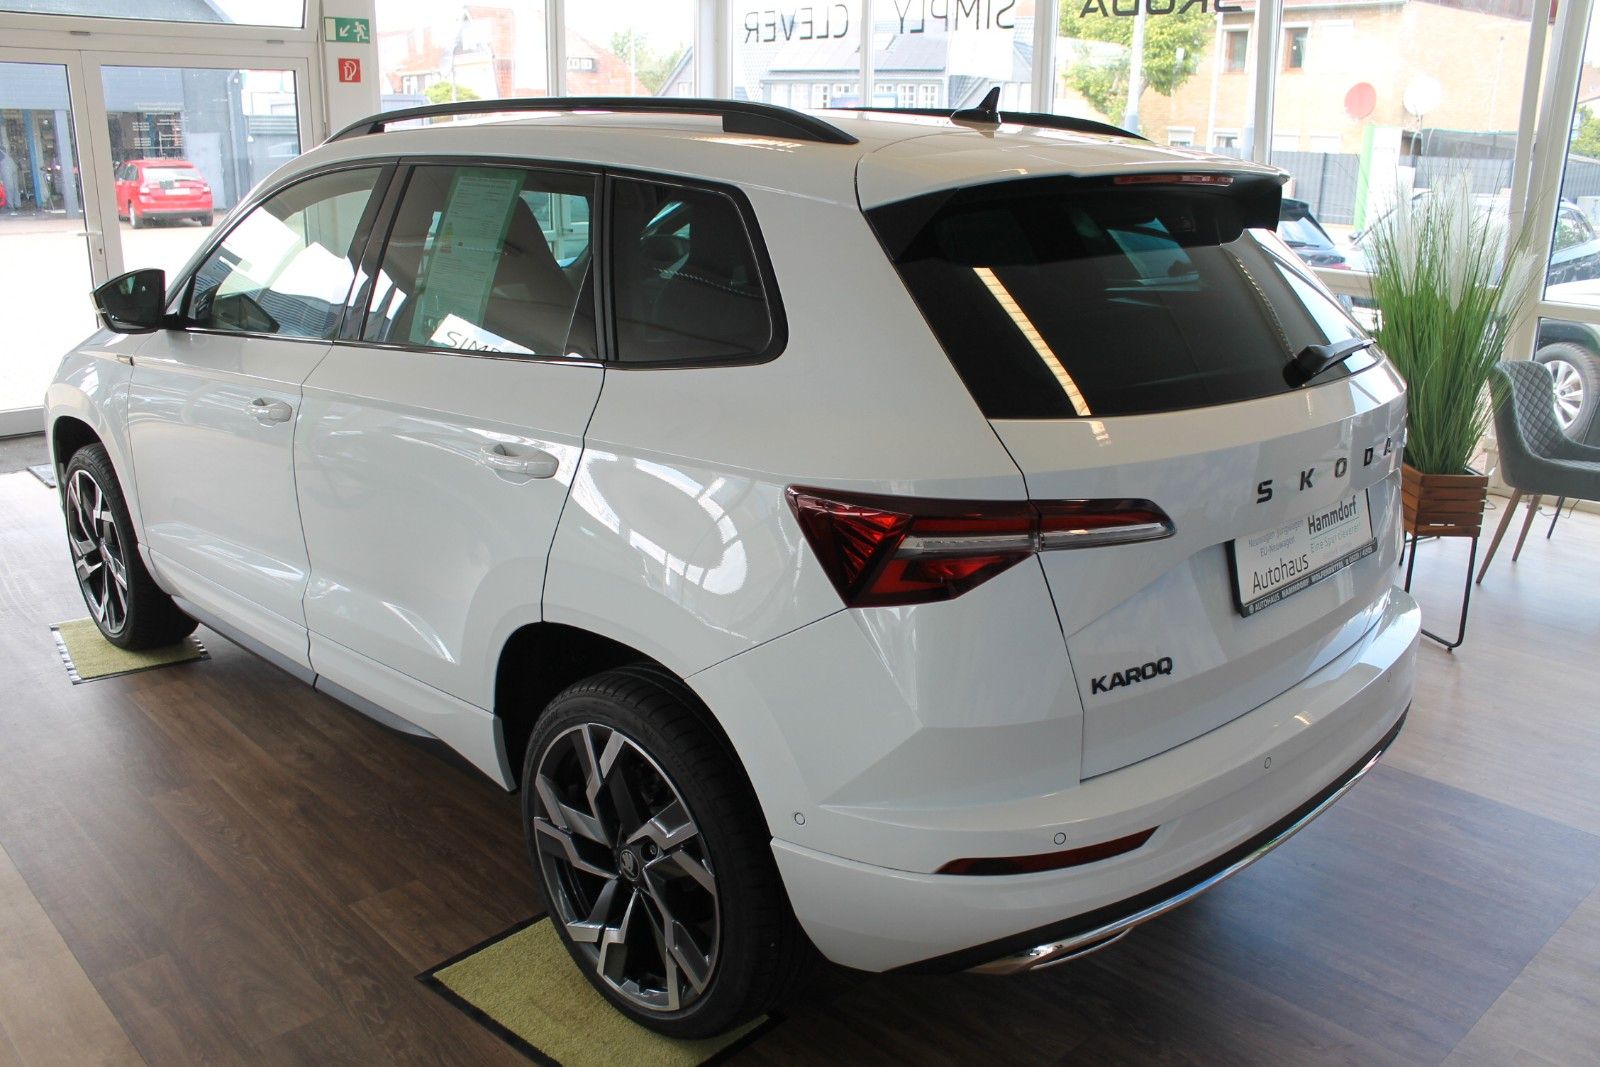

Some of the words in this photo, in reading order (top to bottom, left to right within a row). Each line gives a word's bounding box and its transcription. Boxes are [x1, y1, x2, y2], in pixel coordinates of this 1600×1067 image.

[1256, 437, 1393, 504] SKODA
[1307, 494, 1357, 535] Hammdorf
[1253, 554, 1309, 594] Autohaus
[1091, 656, 1173, 695] KAROQ
